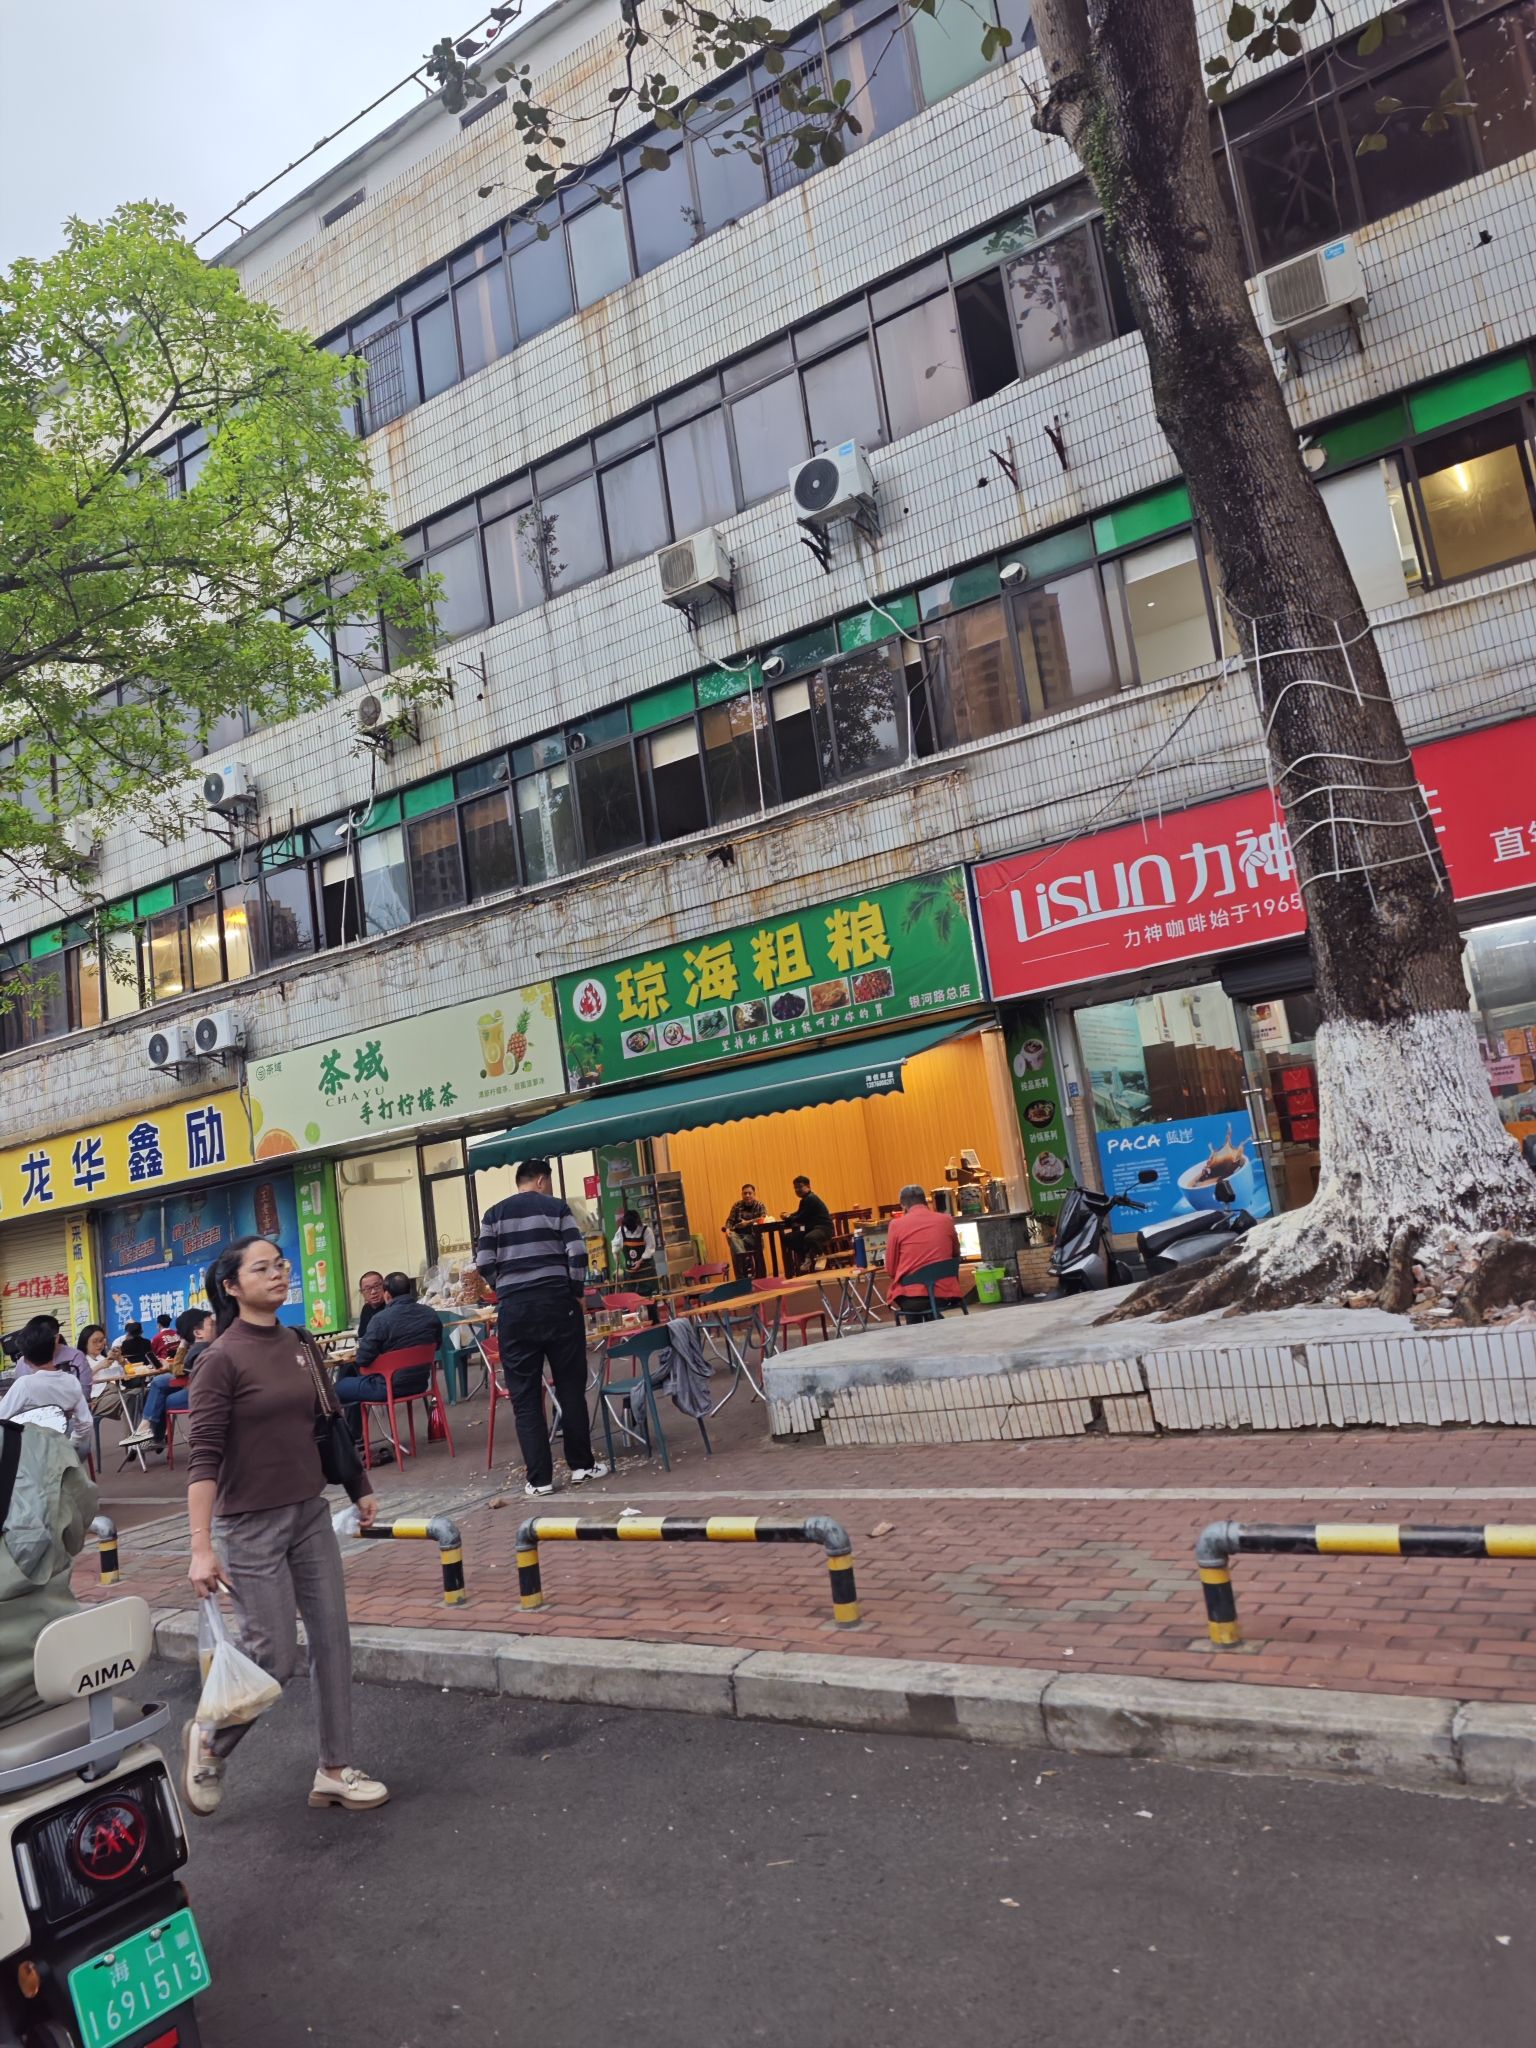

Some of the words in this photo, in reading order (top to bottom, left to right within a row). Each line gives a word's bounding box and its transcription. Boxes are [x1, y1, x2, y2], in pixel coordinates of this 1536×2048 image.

[1180, 821, 1297, 904] 力神
[614, 900, 892, 1023] 琼海粗粮
[908, 983, 972, 1009] 银河路总店
[721, 1003, 884, 1053] 坚持好原料才能呵护你的胃
[318, 1040, 389, 1096] 茶域
[325, 1086, 385, 1107] CHAYU
[359, 1081, 458, 1125] 手打柠檬茶
[21, 1105, 227, 1206] 龙华鑫励
[1107, 1134, 1161, 1154] PACA
[139, 1290, 184, 1322] 蓝带啤酒
[78, 1658, 136, 1693] AIMA
[110, 1940, 166, 1988] 海口
[89, 1952, 202, 2041] 1691513
